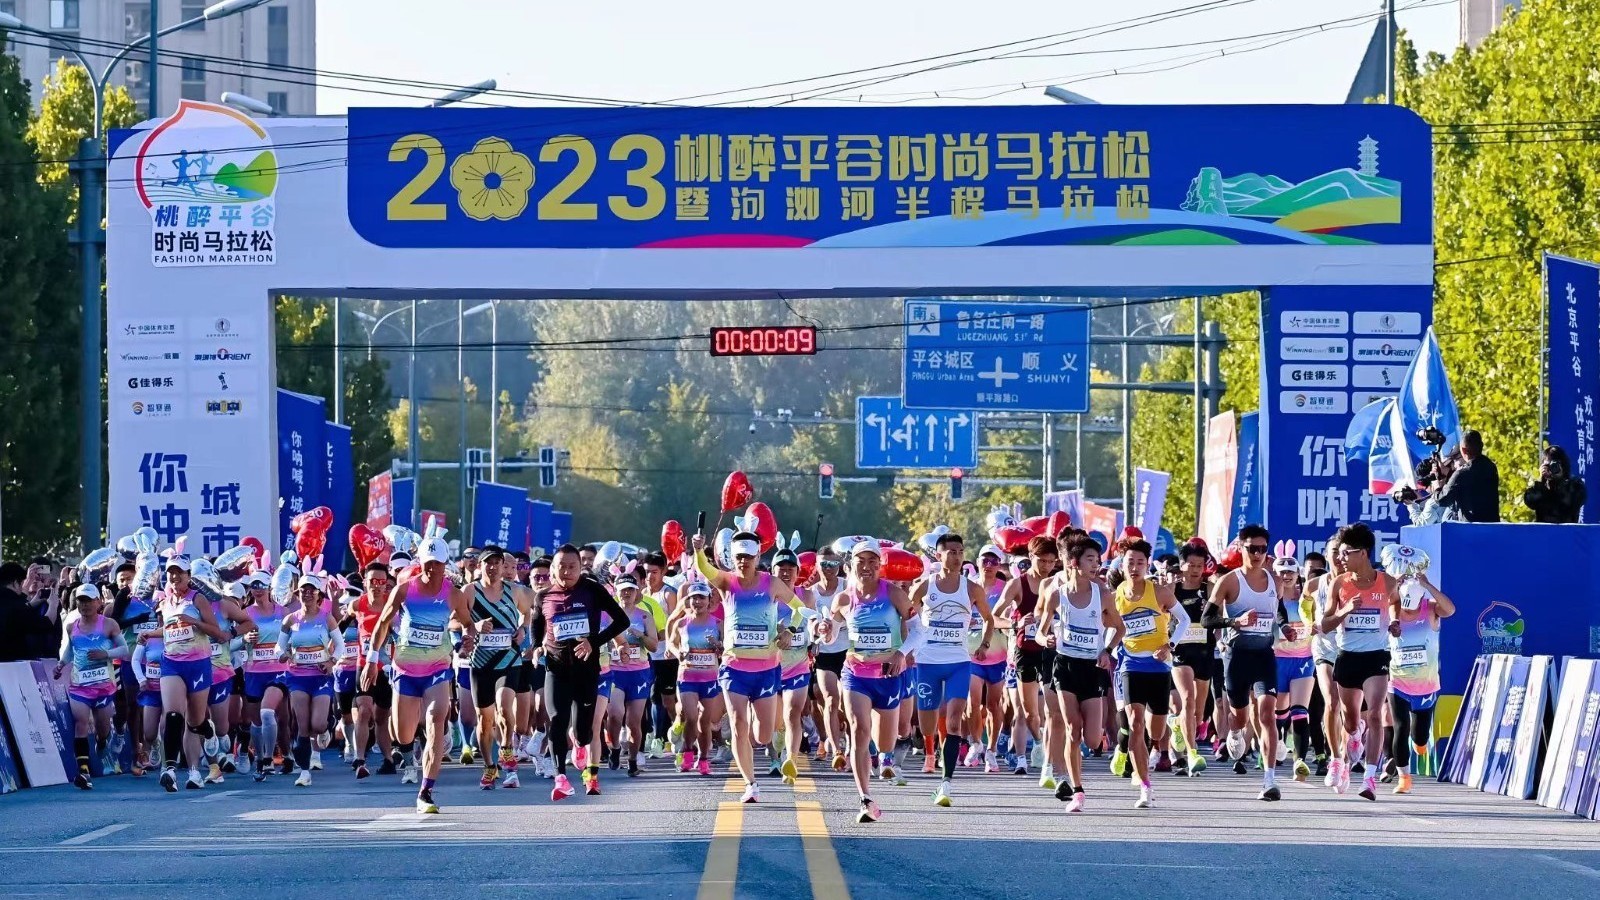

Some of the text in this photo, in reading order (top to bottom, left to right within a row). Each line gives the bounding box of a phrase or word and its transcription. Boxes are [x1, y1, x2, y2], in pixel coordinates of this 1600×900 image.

[673, 131, 1151, 182] 桃醉平谷时尚马拉松
[154, 204, 274, 228] 桃醉平谷
[154, 231, 274, 252] 时尚马拉松
[154, 254, 273, 263] FASHION MARATHON
[914, 306, 926, 320] 南
[715, 330, 813, 353] 00:00:09
[1033, 333, 1044, 342] Rd
[912, 350, 975, 369] 平谷城区
[1021, 352, 1078, 371] 顺义
[1027, 375, 1071, 384] SHUNYI
[1303, 371, 1337, 380] 佳得乐
[140, 377, 174, 388] 佳得乐
[1565, 283, 1587, 483] 北京平谷·体育休
[363, 534, 385, 550] 2:30
[1349, 616, 1376, 624] A1789
[558, 621, 585, 631] A0777
[411, 632, 440, 641] A2534
[736, 633, 765, 641] A2533
[933, 630, 960, 638] A1965
[1066, 634, 1094, 644] A1084
[82, 669, 106, 679] A2542
